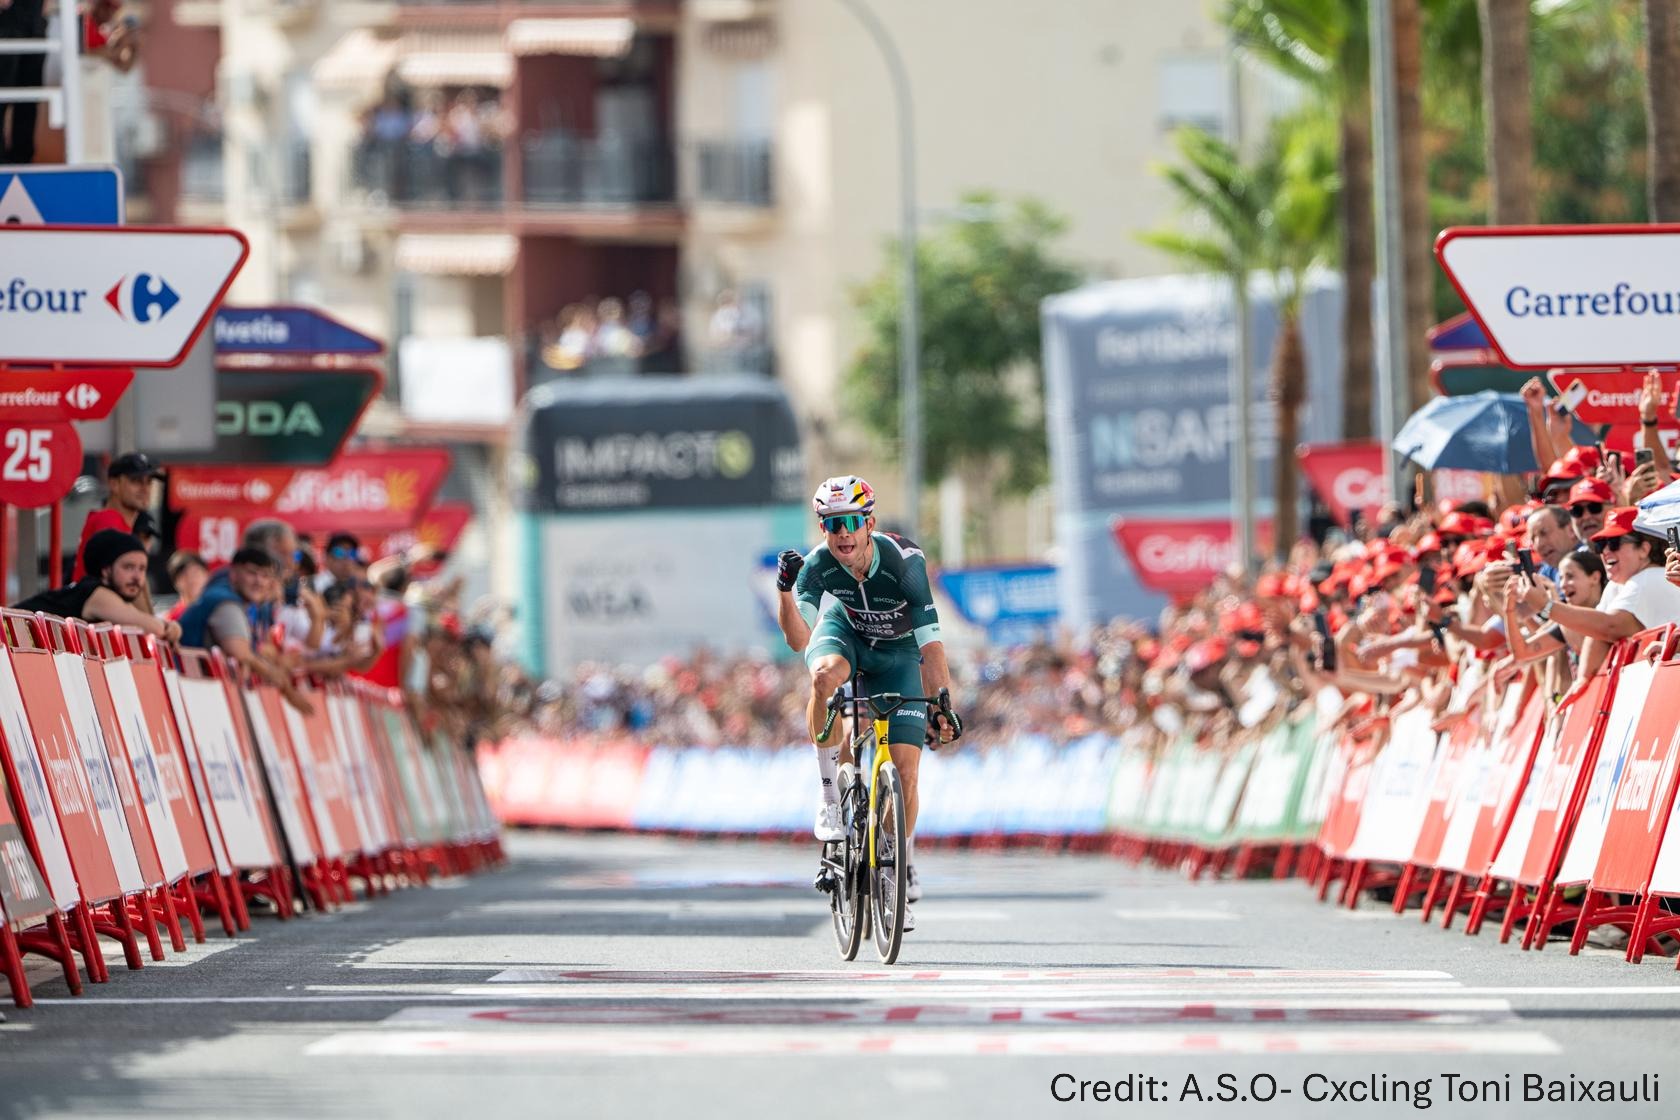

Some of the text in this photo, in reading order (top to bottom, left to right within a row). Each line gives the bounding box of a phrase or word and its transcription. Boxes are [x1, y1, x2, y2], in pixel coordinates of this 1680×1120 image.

[1506, 282, 1680, 317] Carrefou
[1587, 388, 1670, 407] Carrefr
[3, 428, 53, 482] 25
[199, 517, 238, 563] 50
[896, 709, 926, 719] Santini
